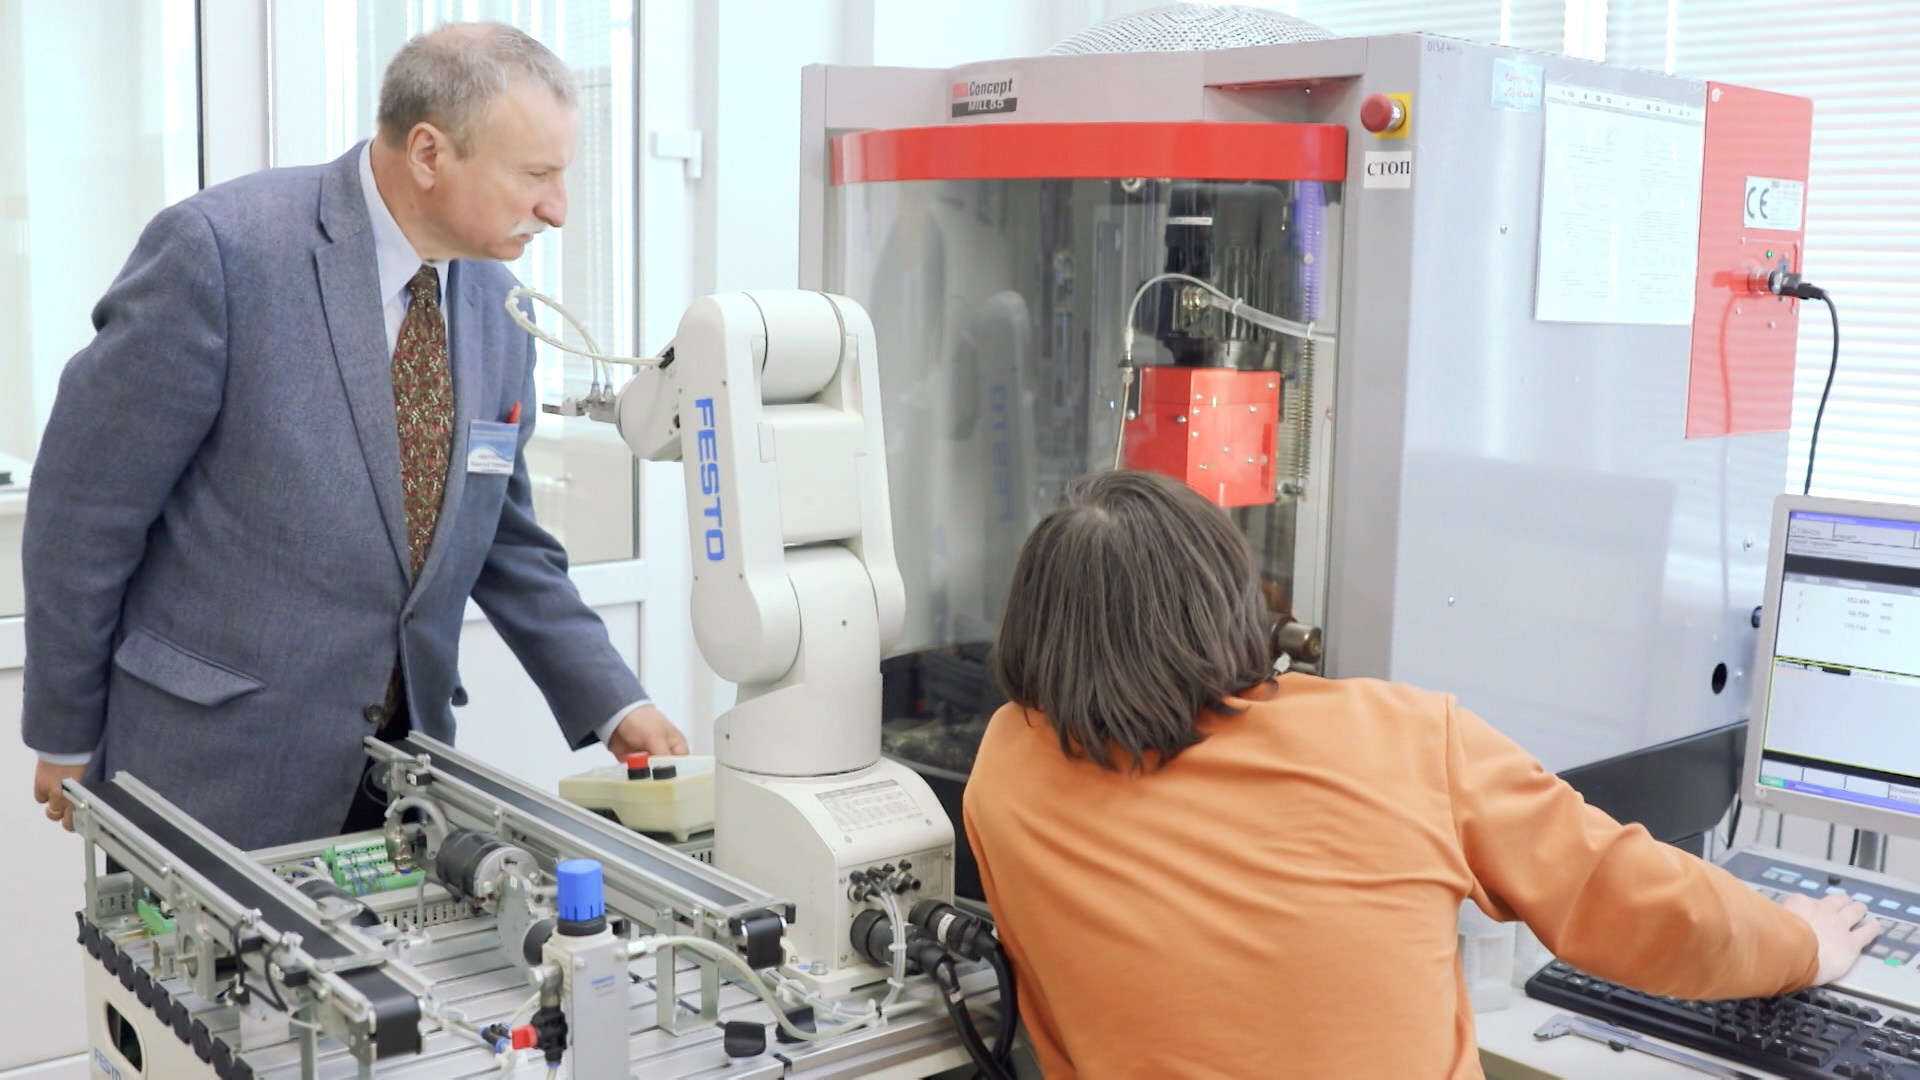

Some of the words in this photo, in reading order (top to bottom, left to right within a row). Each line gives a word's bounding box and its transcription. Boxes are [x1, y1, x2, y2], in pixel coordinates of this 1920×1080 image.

[969, 78, 1013, 96] Concept
[968, 99, 988, 111] MILL
[1367, 160, 1410, 176] СТОП
[695, 398, 725, 561] FESTO
